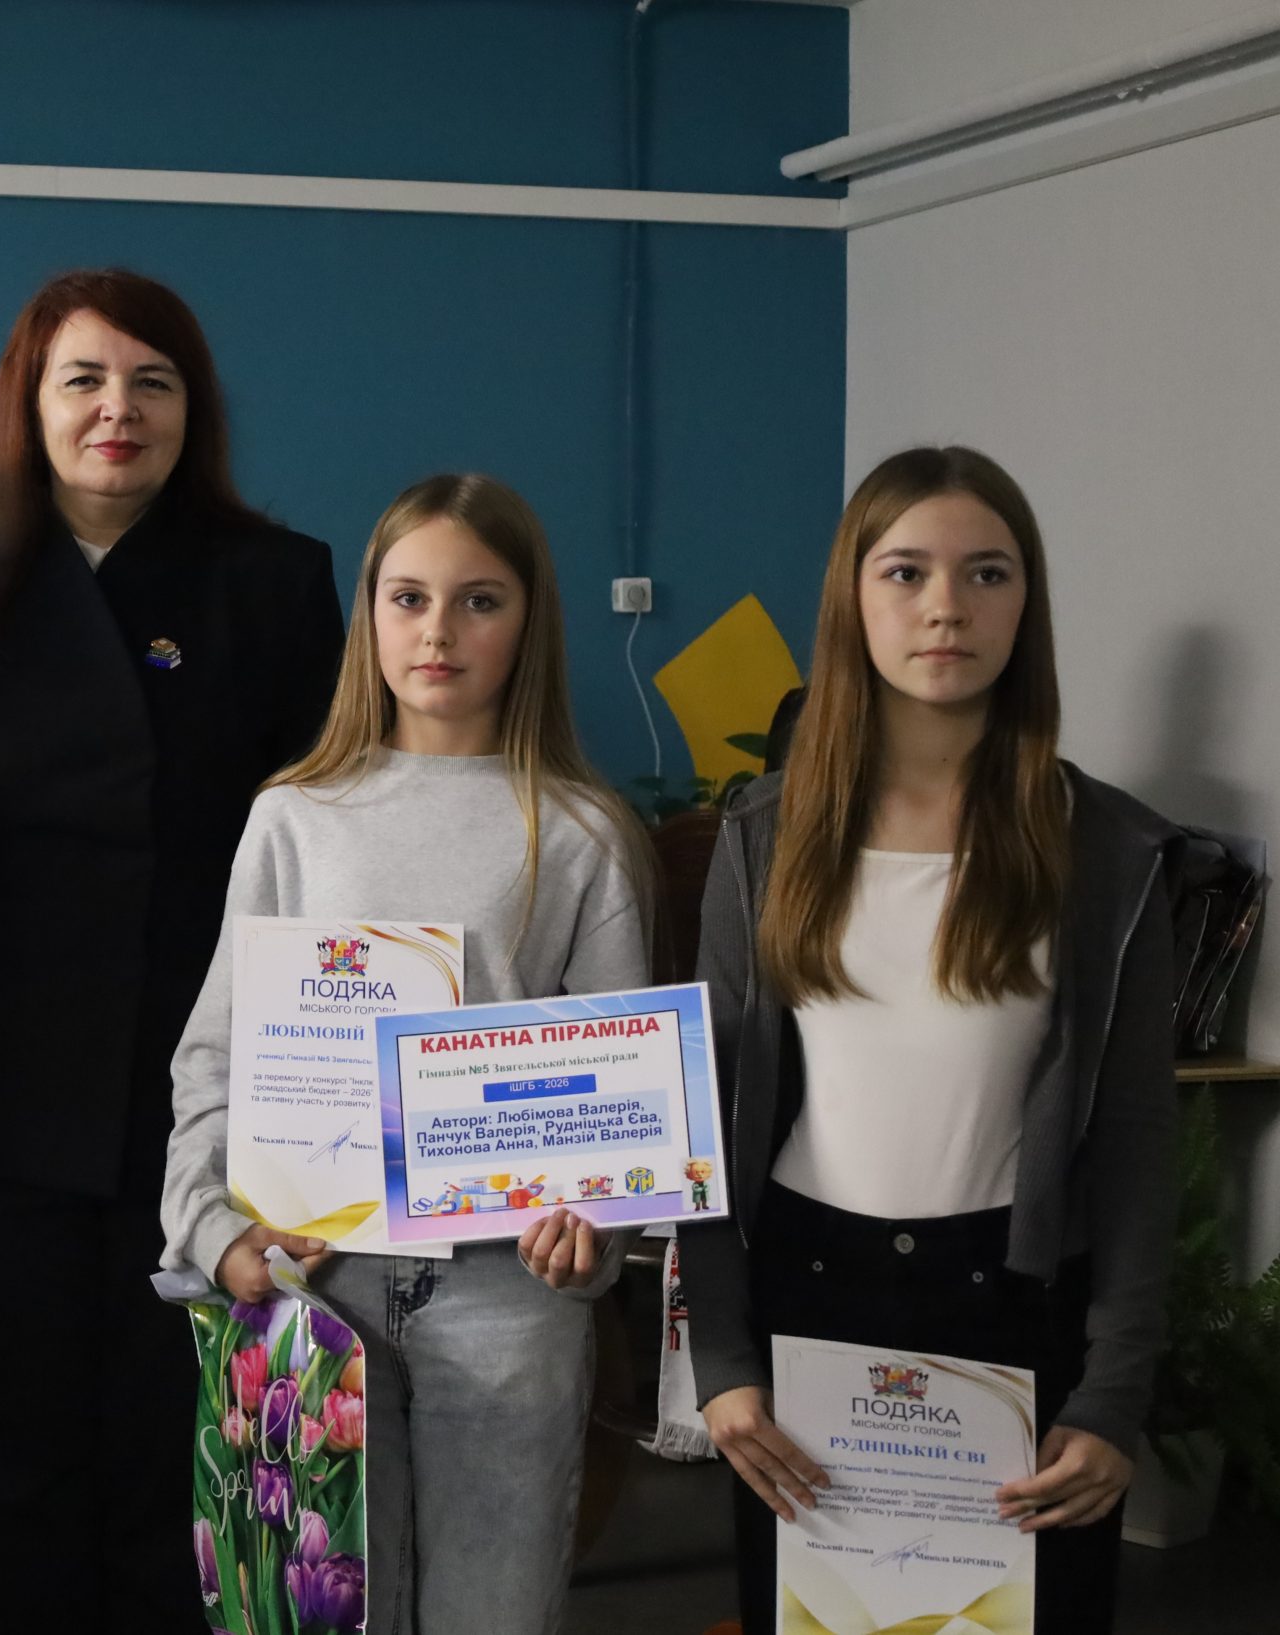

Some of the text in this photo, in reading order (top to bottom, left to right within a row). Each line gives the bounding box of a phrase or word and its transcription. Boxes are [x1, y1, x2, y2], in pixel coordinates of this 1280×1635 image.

[300, 979, 397, 1002] ПОДЯКА
[299, 1003, 352, 1014] МІСЬКОГО
[258, 1024, 365, 1041] ЛЮБІМОВІЙ
[420, 1016, 660, 1054] КАНАТНА ПІРАМІДА
[418, 1052, 639, 1079] Гімназія №5 Звягельської міської ради
[253, 1084, 306, 1093] громадський
[308, 1085, 340, 1095] бюджет
[264, 1074, 303, 1083] перемогу
[312, 1076, 347, 1086] конкурсі
[544, 1078, 569, 1089] 2026
[262, 1096, 295, 1104] активну
[296, 1097, 324, 1106] участь
[326, 1099, 332, 1107] у
[333, 1099, 371, 1109] розвитку
[431, 1099, 645, 1129] Автори: Любімова Валерія,
[416, 1112, 662, 1145] Панчук Валерія, Рудніцька Єва,
[417, 1125, 662, 1158] Тихонова Анна, Манзій Валерія
[222, 1374, 320, 1464] Hello
[852, 1397, 961, 1425] ПОДЯКА
[851, 1418, 962, 1439] МІСЬКОГО ГОЛОВИ
[830, 1436, 986, 1464] РУДНІЦЬКІЙ ЄВІ
